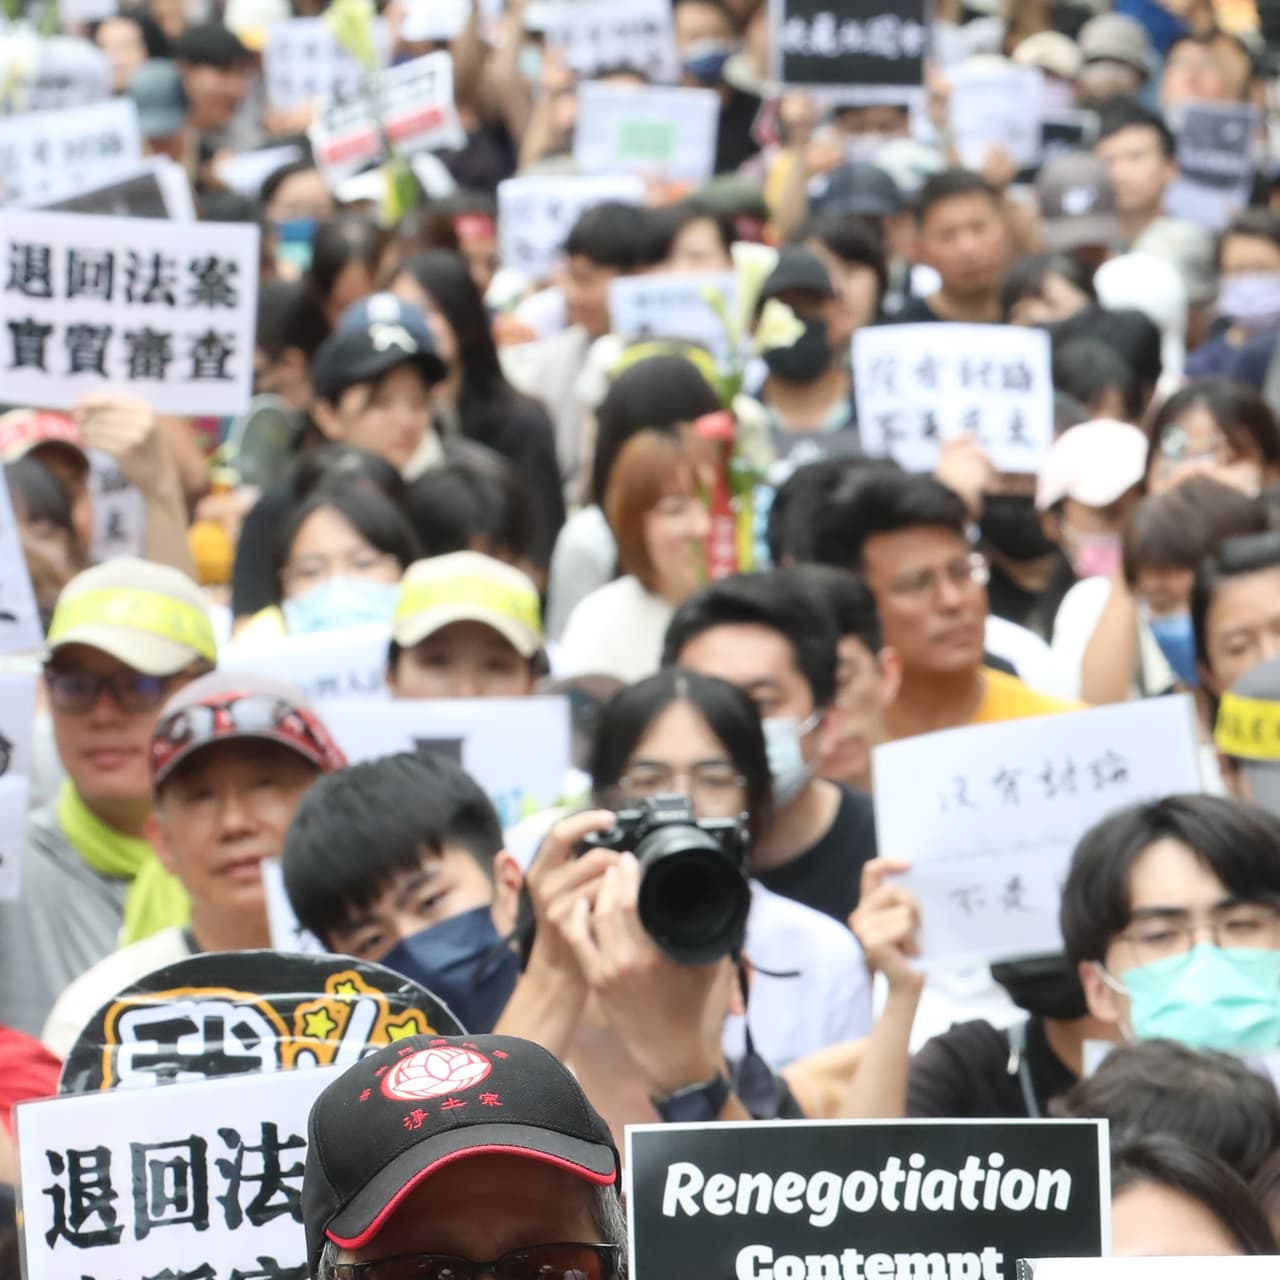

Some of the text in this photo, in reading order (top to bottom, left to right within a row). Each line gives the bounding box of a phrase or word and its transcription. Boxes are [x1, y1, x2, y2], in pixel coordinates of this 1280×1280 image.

[5, 242, 240, 308] 退回法案
[6, 317, 236, 381] 實質審查
[403, 1092, 503, 1131] 淨土宗
[662, 1152, 1072, 1228] Renegotiation
